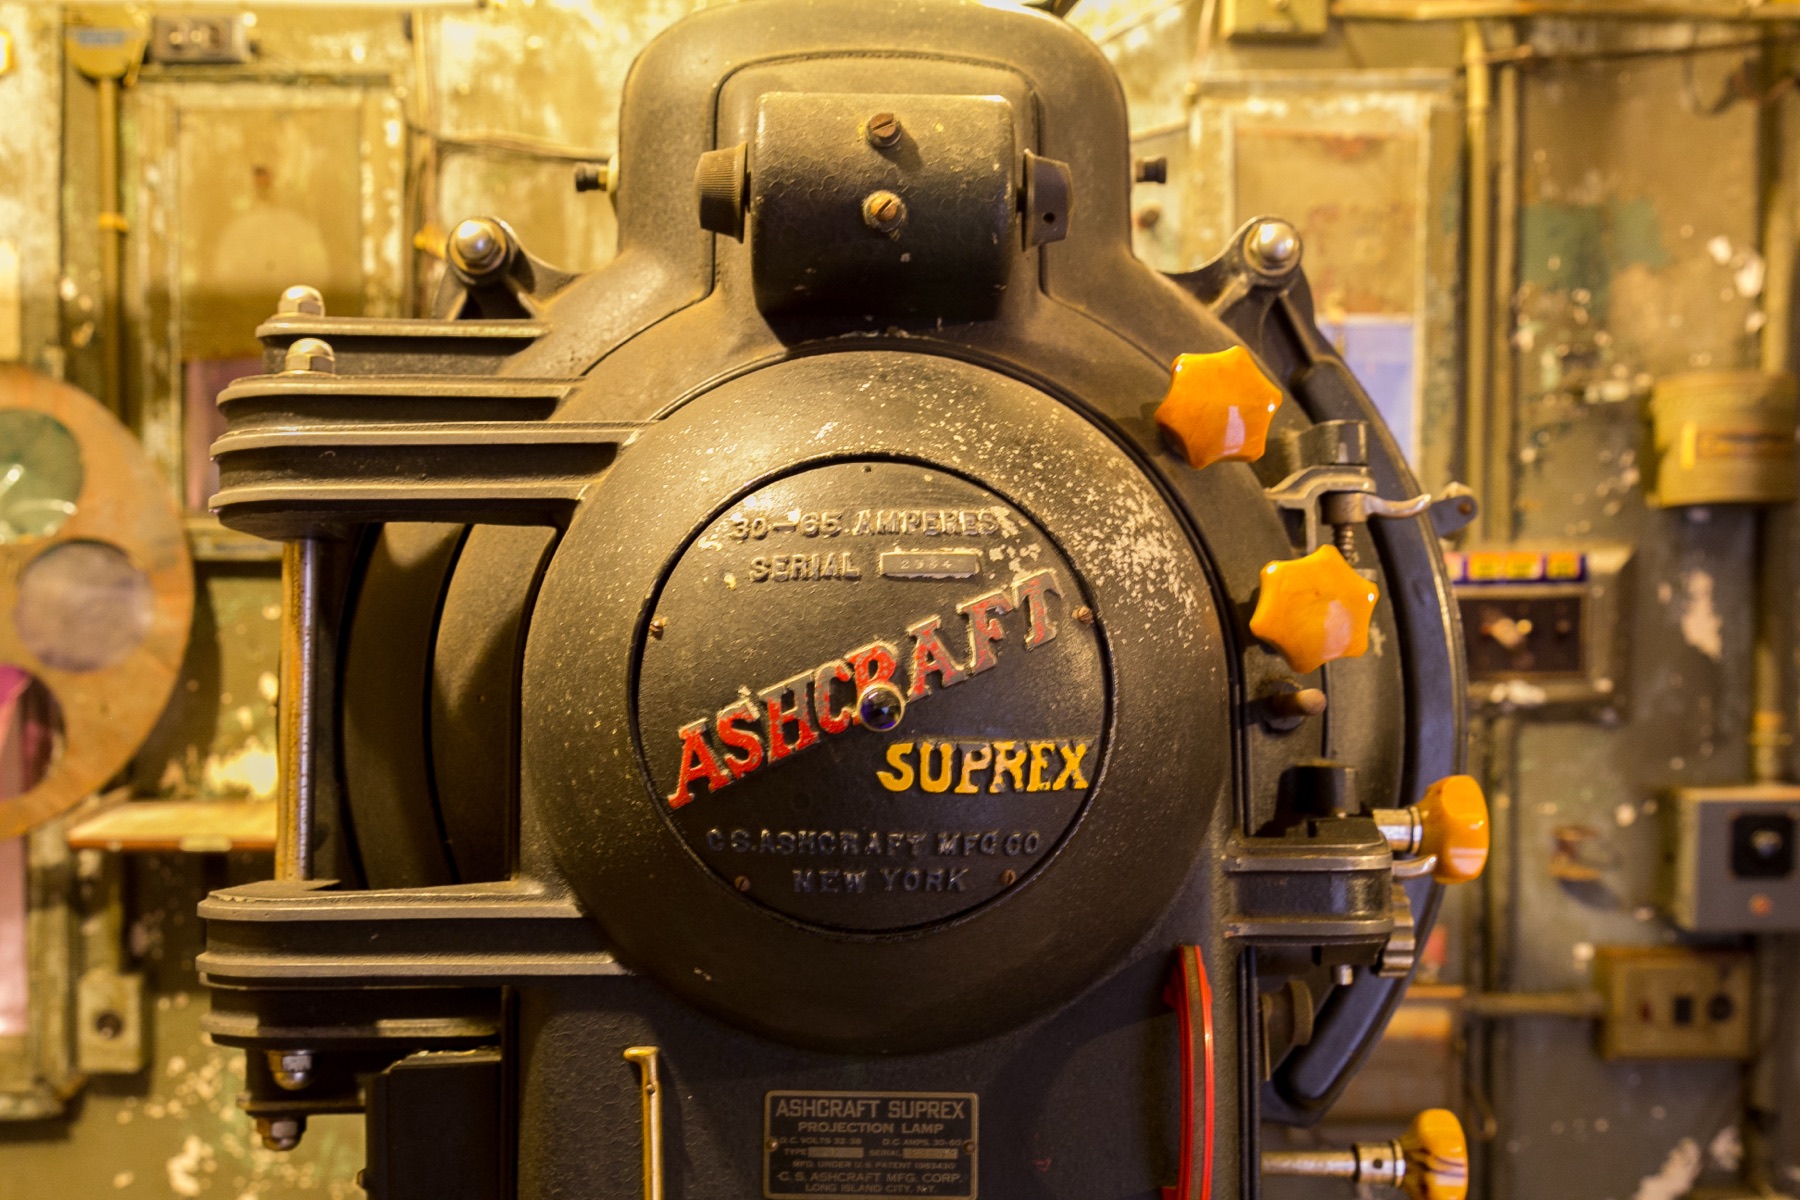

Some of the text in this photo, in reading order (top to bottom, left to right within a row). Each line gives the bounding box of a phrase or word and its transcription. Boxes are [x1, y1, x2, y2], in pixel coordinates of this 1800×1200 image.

[853, 509, 1000, 537] AMPERES
[749, 550, 861, 583] SERIAL
[668, 569, 1063, 809] ASHCRAFT
[877, 739, 1090, 794] SUPREX
[792, 867, 969, 893] NEW YORK
[776, 1100, 965, 1119] ASHCRAFT SUPREX
[798, 1122, 944, 1134] PROJECTION LAMP
[783, 1147, 808, 1156] TYPE
[868, 1149, 903, 1157] SERIAL
[817, 1160, 852, 1168] UNDER
[874, 1161, 912, 1169] PATENT
[809, 1172, 882, 1183] ASHCRAFT
[805, 1183, 837, 1193] LONG
[840, 1184, 882, 1194] ISLAND
